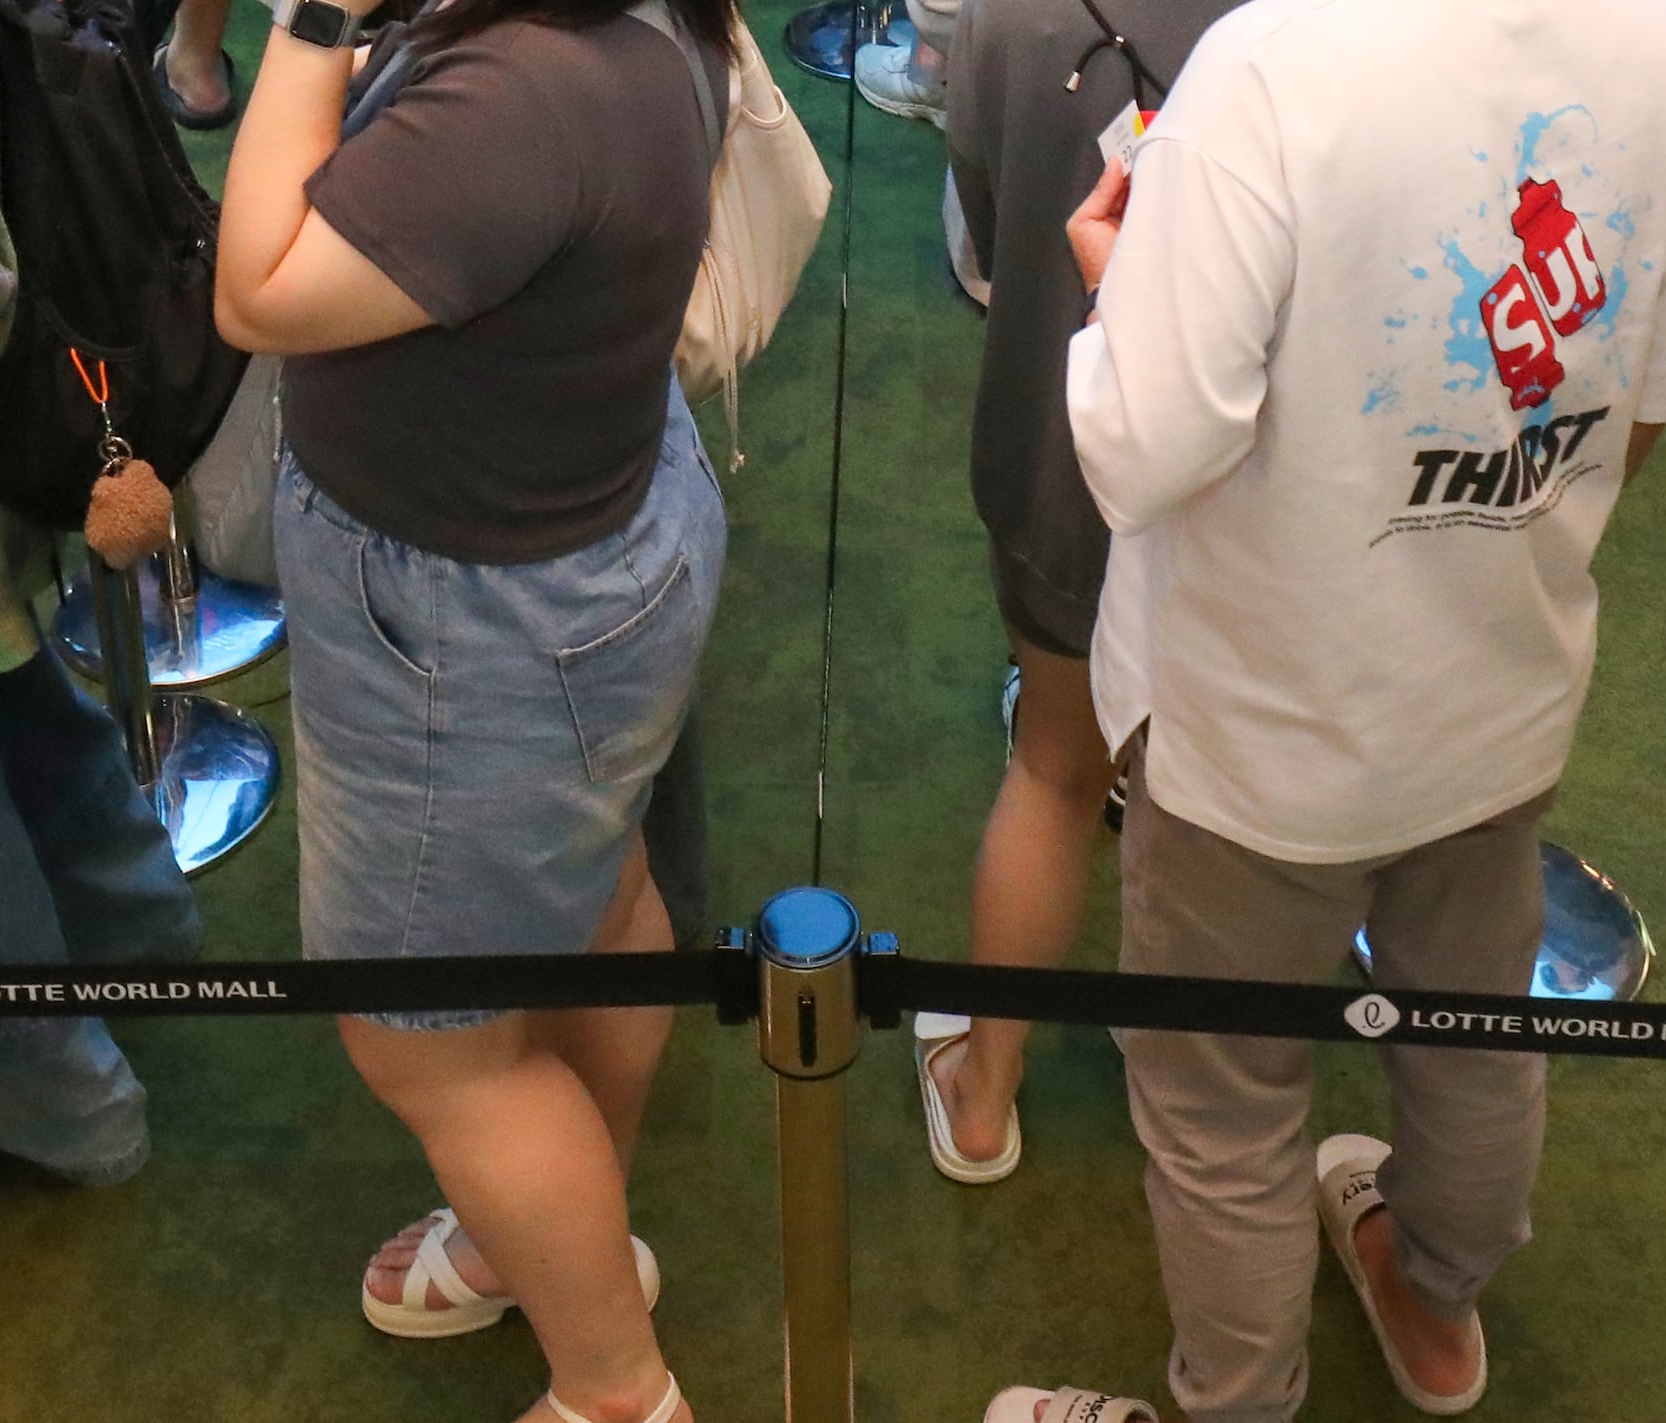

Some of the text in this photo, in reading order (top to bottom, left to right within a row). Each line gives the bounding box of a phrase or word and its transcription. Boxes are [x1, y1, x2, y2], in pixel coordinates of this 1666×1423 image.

[1408, 406, 1611, 508] THIRST
[71, 981, 191, 1001] WORLD
[197, 980, 288, 999] MALL
[1410, 1009, 1523, 1033] LOTTE
[1532, 1016, 1654, 1041] WORLD
